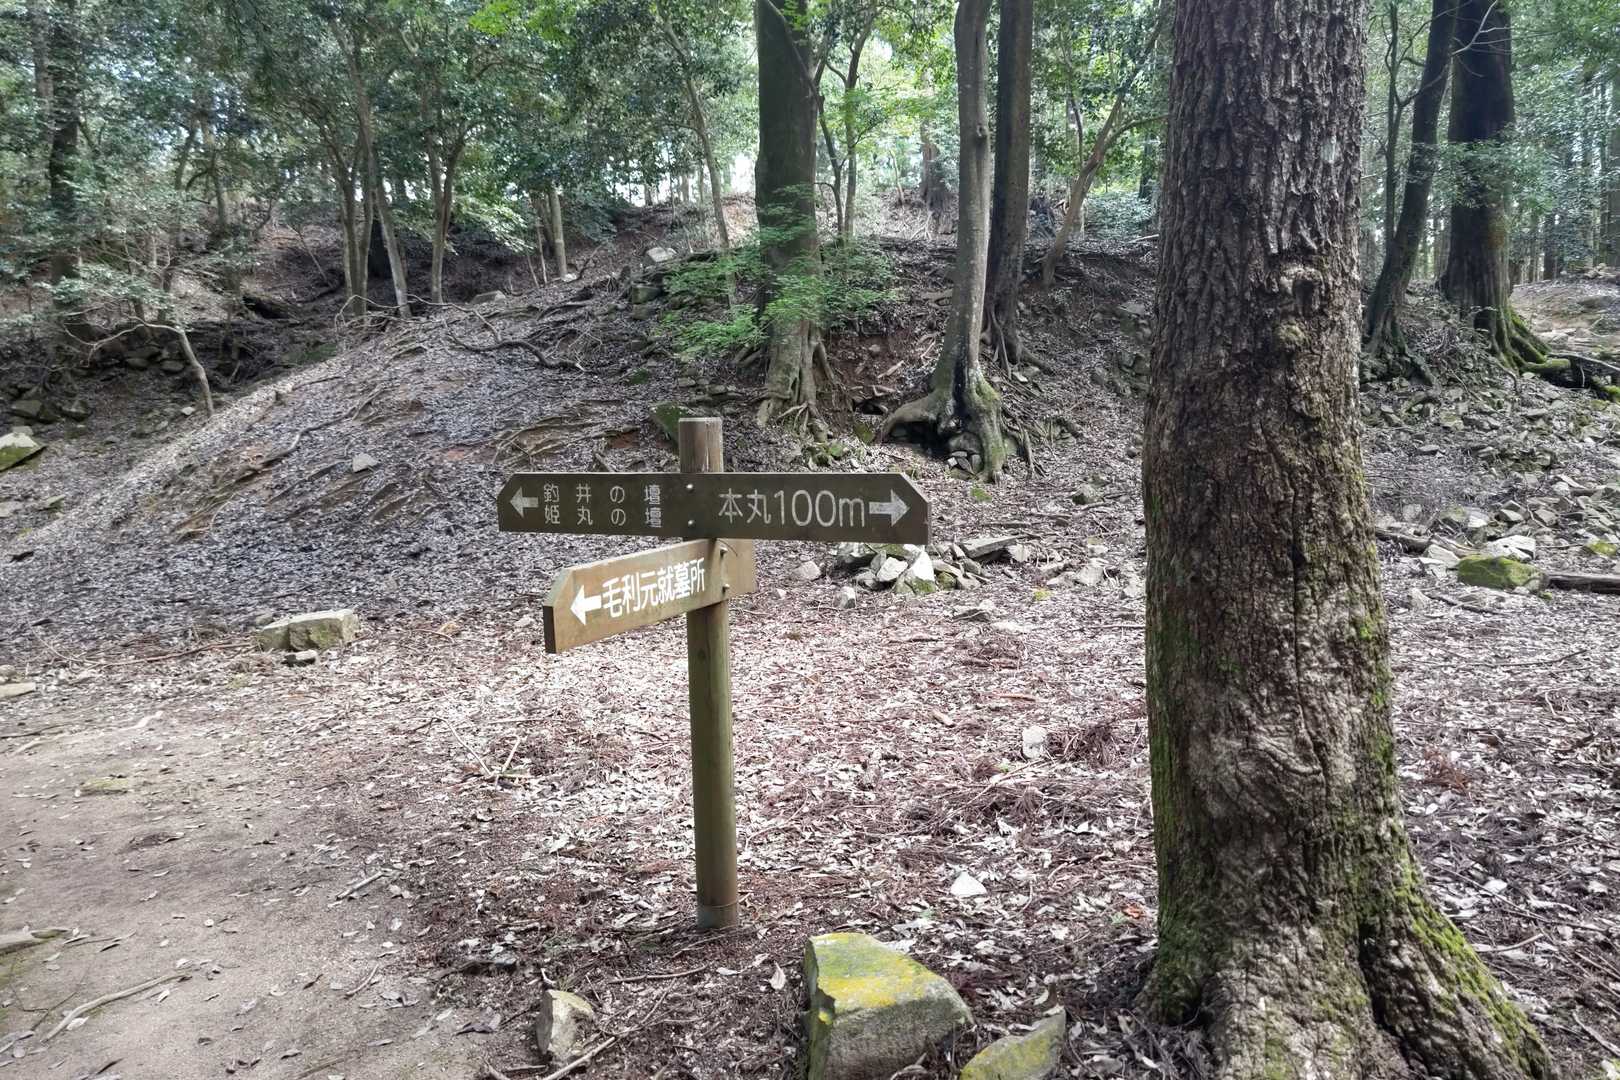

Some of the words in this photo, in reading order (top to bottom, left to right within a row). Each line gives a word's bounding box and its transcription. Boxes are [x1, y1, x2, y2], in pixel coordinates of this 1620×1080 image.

[718, 488, 865, 528] 本丸100m
[602, 557, 705, 618] 毛利元就墓所
